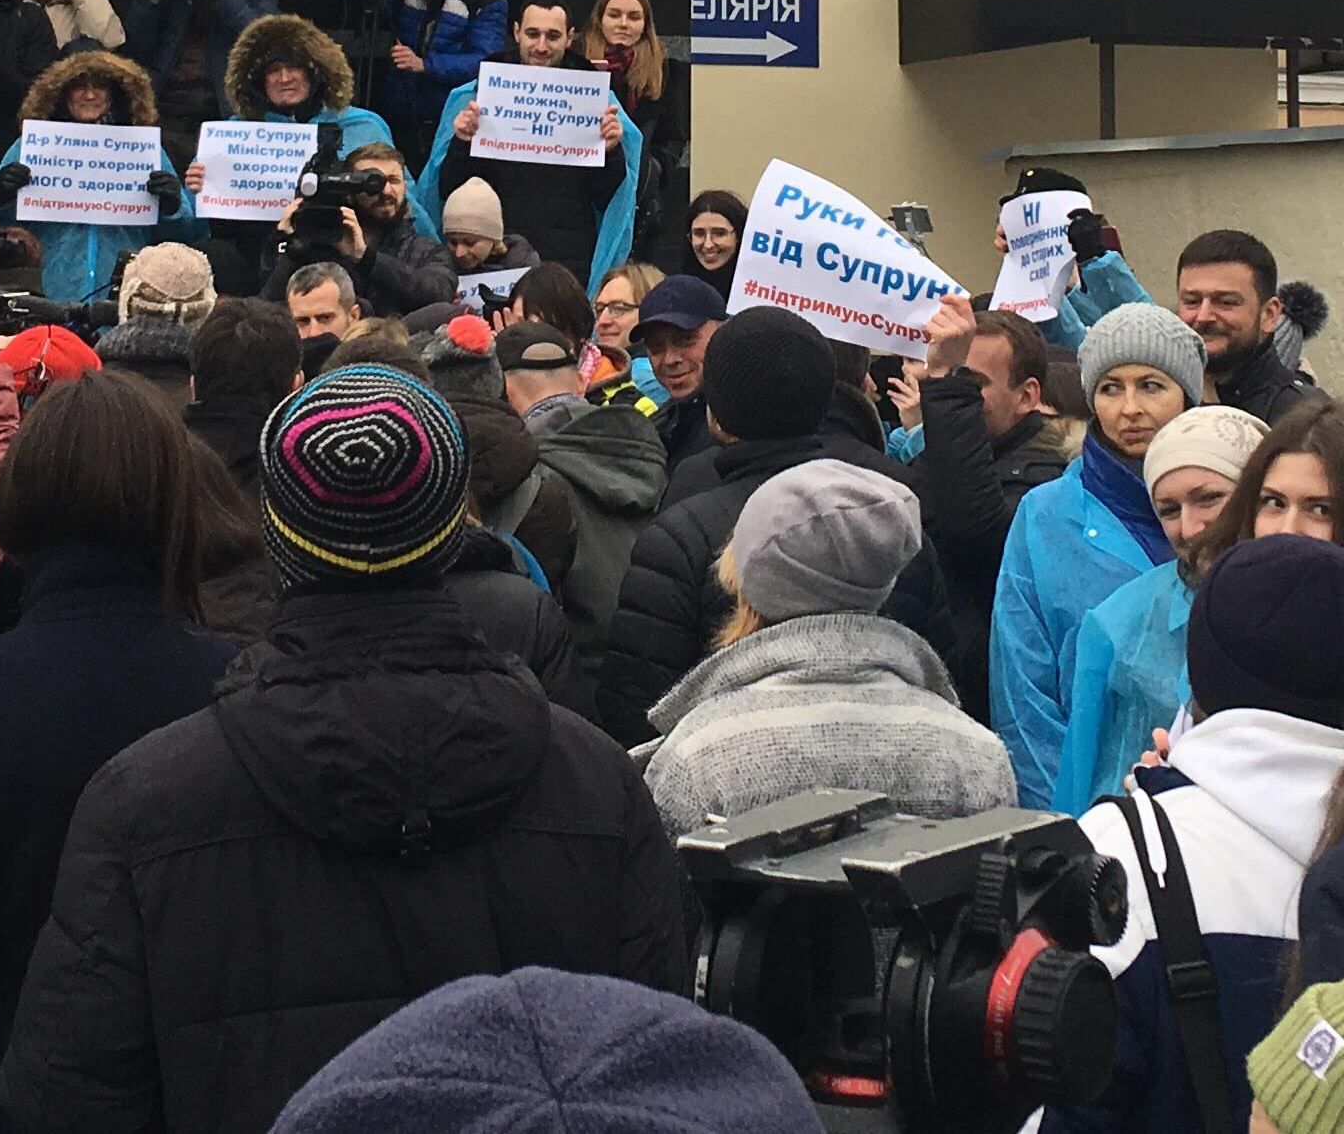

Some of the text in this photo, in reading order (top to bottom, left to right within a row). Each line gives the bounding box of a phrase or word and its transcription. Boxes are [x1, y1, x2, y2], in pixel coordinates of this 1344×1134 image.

[488, 76, 600, 96] Манту мочити
[513, 96, 573, 111] можна,
[480, 106, 603, 128] а Уляну Супрун
[206, 127, 312, 143] Уляну Супрун
[532, 124, 554, 136] НІ!
[25, 133, 156, 153] Д-р Уляна Супрун
[227, 143, 306, 158] Міністром
[479, 138, 599, 156] #підтримуюСупрун
[25, 154, 154, 172] Міністр охорони
[233, 162, 299, 175] охорони
[28, 176, 73, 188] МОГО
[23, 197, 152, 214] #підтримуюСупрун
[775, 184, 867, 231] Руки
[1022, 201, 1041, 226] НІ
[751, 229, 803, 268] від
